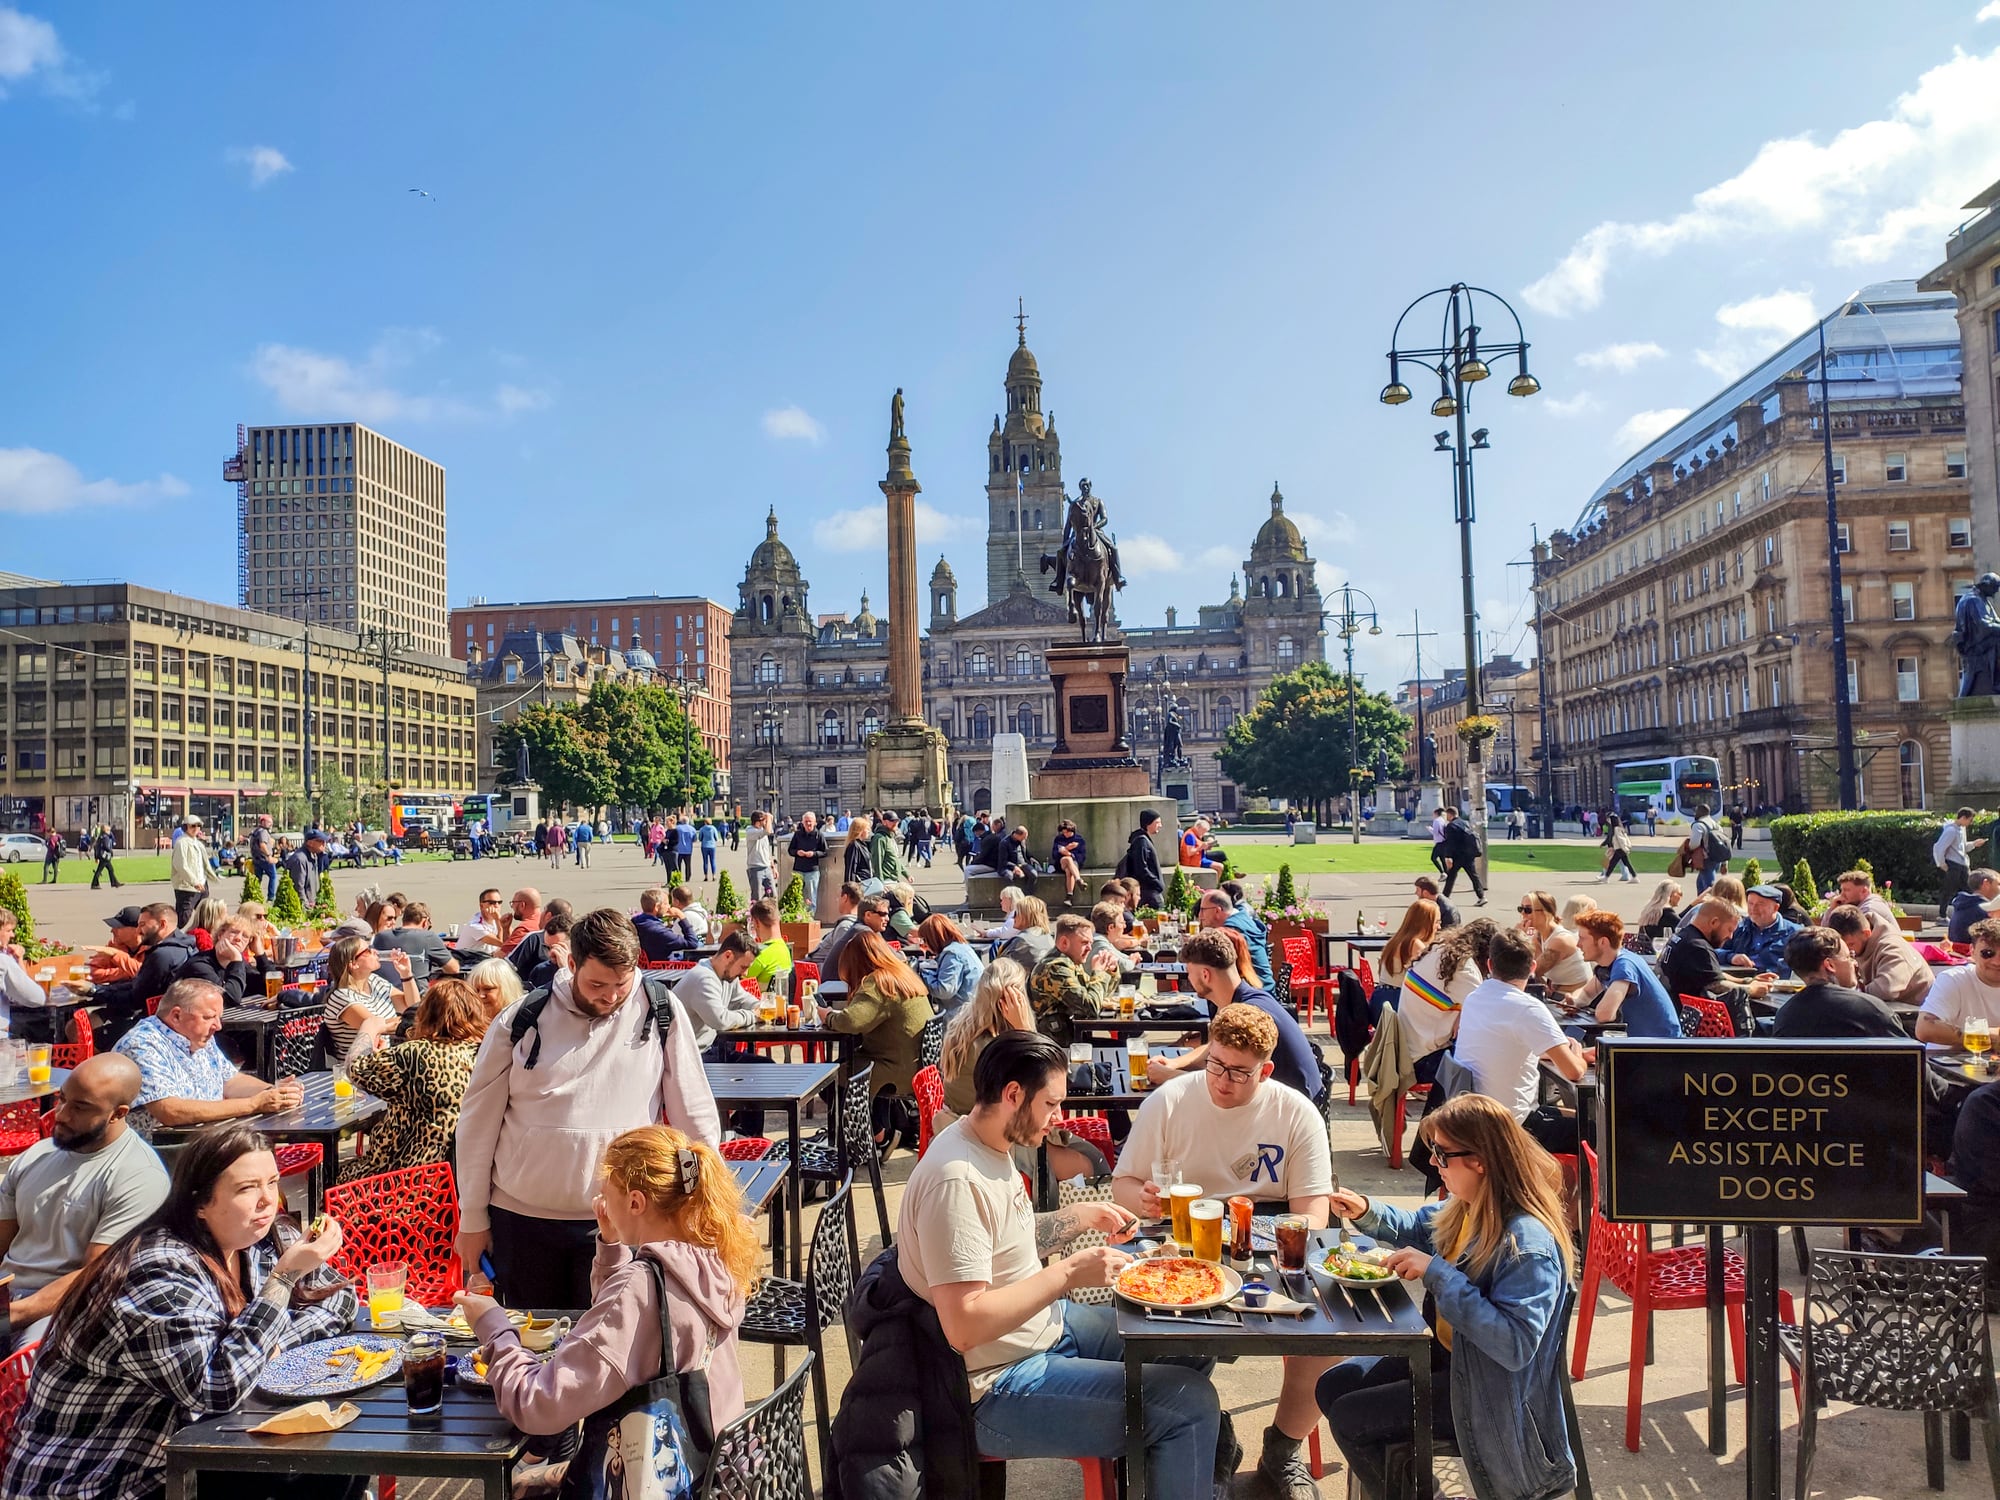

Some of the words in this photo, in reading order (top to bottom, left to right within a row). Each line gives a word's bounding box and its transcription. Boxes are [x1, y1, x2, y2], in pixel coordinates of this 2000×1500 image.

[1684, 1072, 1737, 1096] NO
[1752, 1073, 1849, 1098] DOGS
[1704, 1107, 1829, 1132] EXCEPT
[1668, 1141, 1865, 1167] ASSISTANCE
[1719, 1176, 1815, 1201] DOGS
